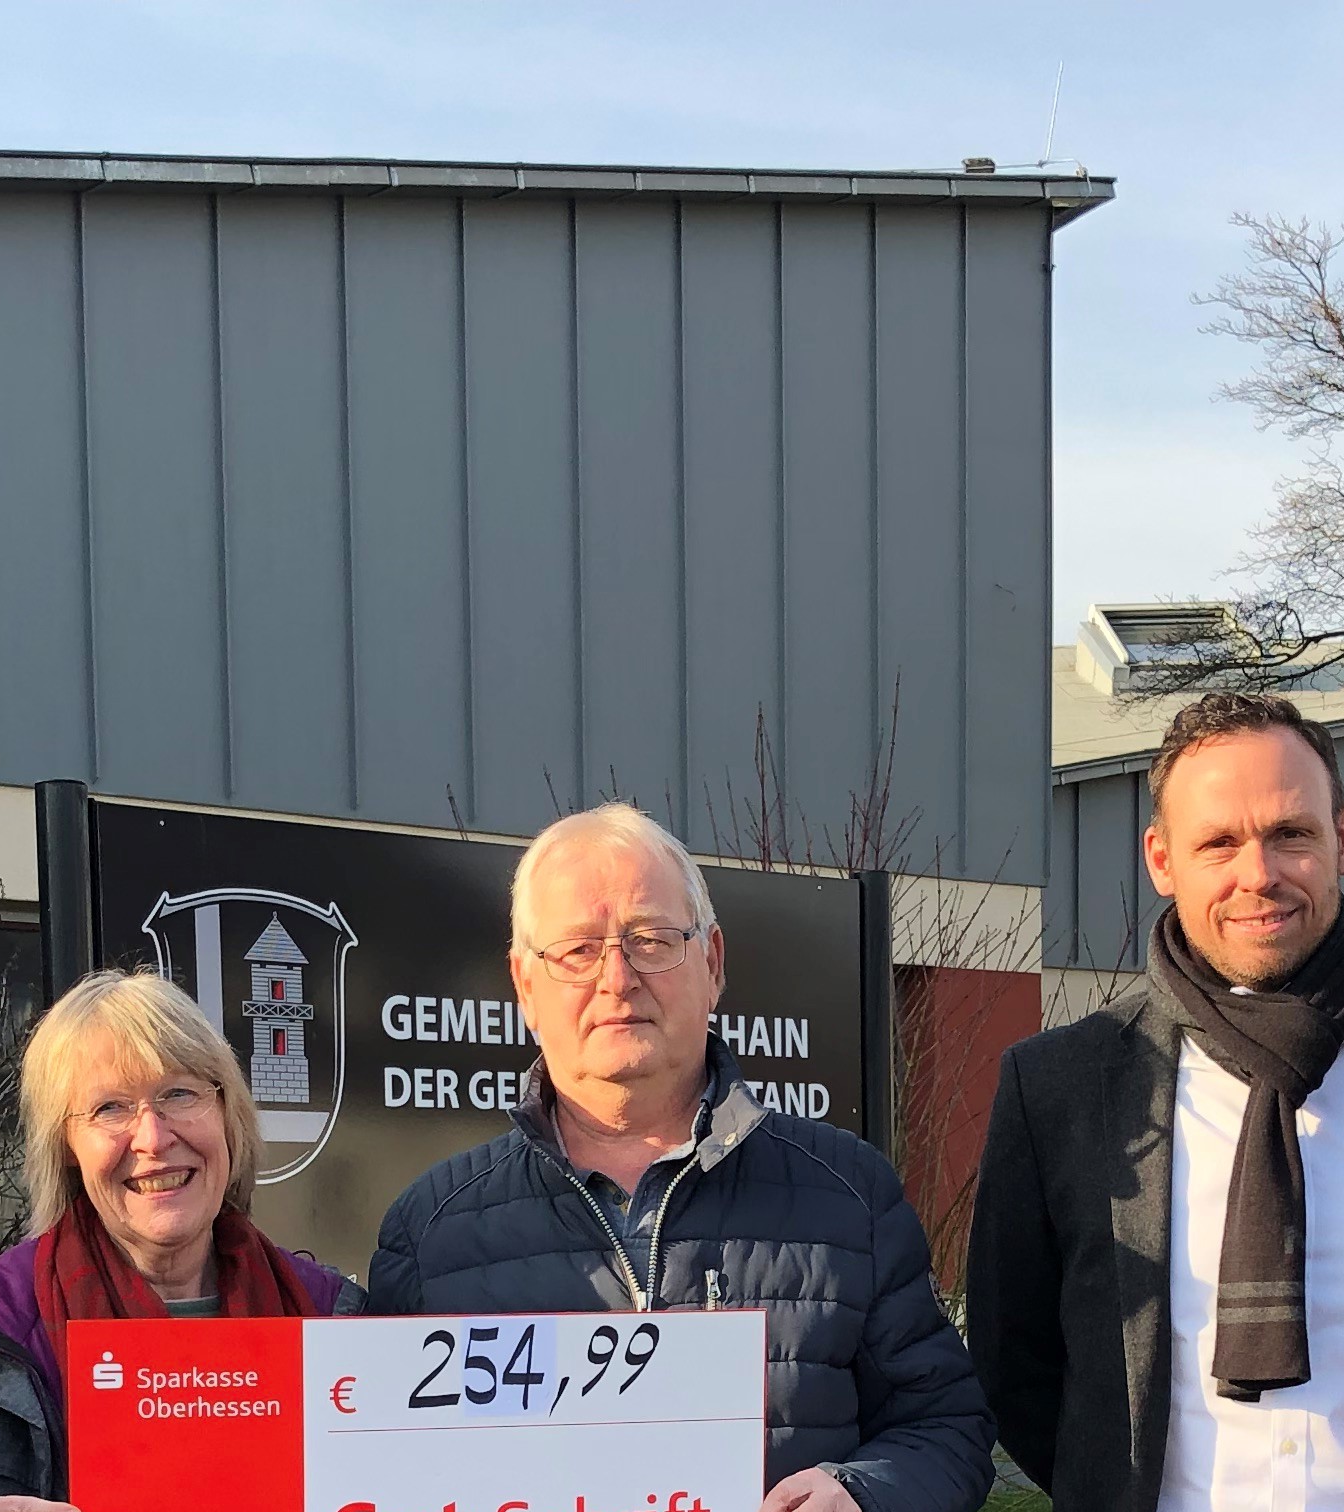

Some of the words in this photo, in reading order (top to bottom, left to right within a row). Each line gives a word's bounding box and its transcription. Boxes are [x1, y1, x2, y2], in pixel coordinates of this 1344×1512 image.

[708, 1013, 809, 1059] HAIN
[383, 1066, 460, 1110] DER
[136, 1366, 258, 1394] Sparkasse
[407, 1321, 661, 1418] 254,99
[137, 1396, 280, 1419] Oberhessen
[329, 1375, 357, 1415] €
